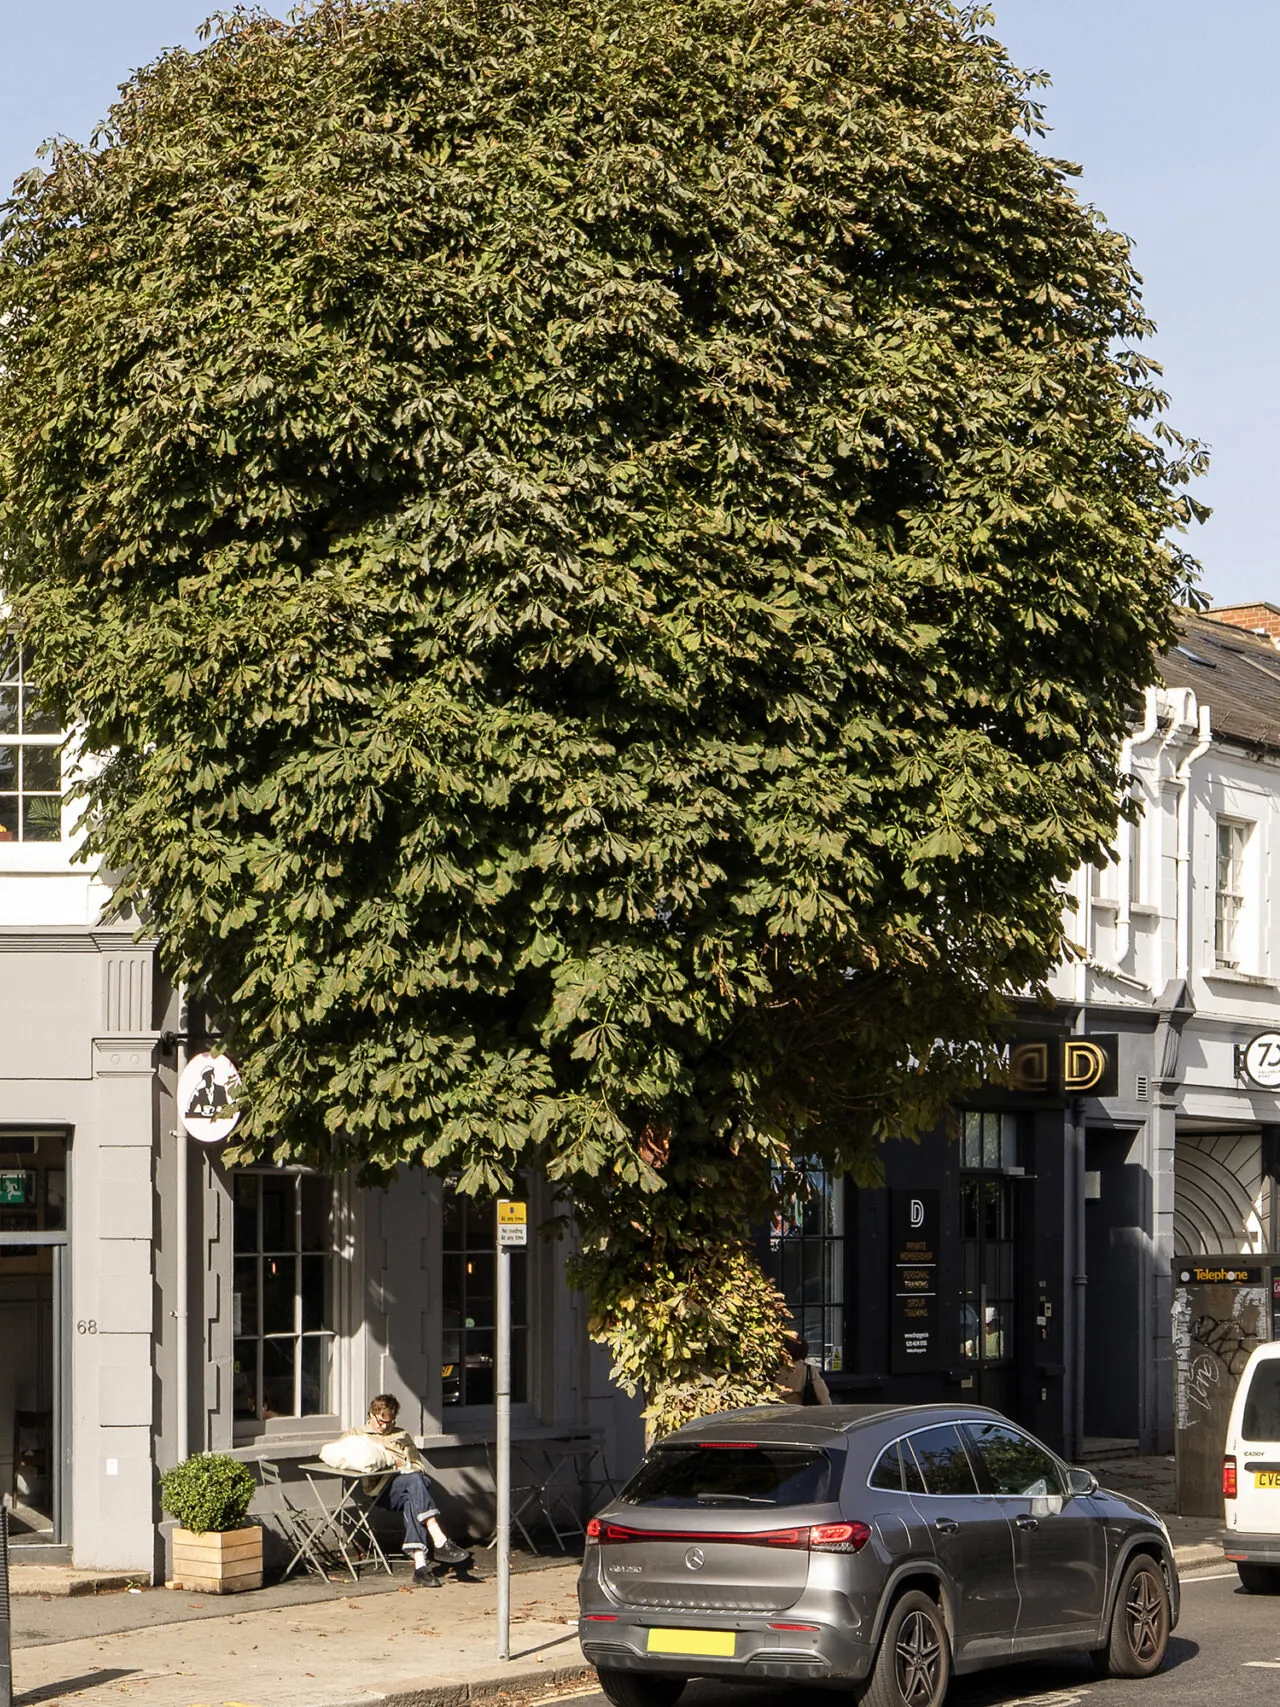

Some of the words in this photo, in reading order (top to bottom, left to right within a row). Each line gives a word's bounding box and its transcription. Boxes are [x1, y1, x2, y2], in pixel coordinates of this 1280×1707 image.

[1064, 1041, 1105, 1091] D
[910, 1199, 925, 1228] D
[1194, 1268, 1248, 1282] Telephne
[77, 1319, 98, 1335] 68
